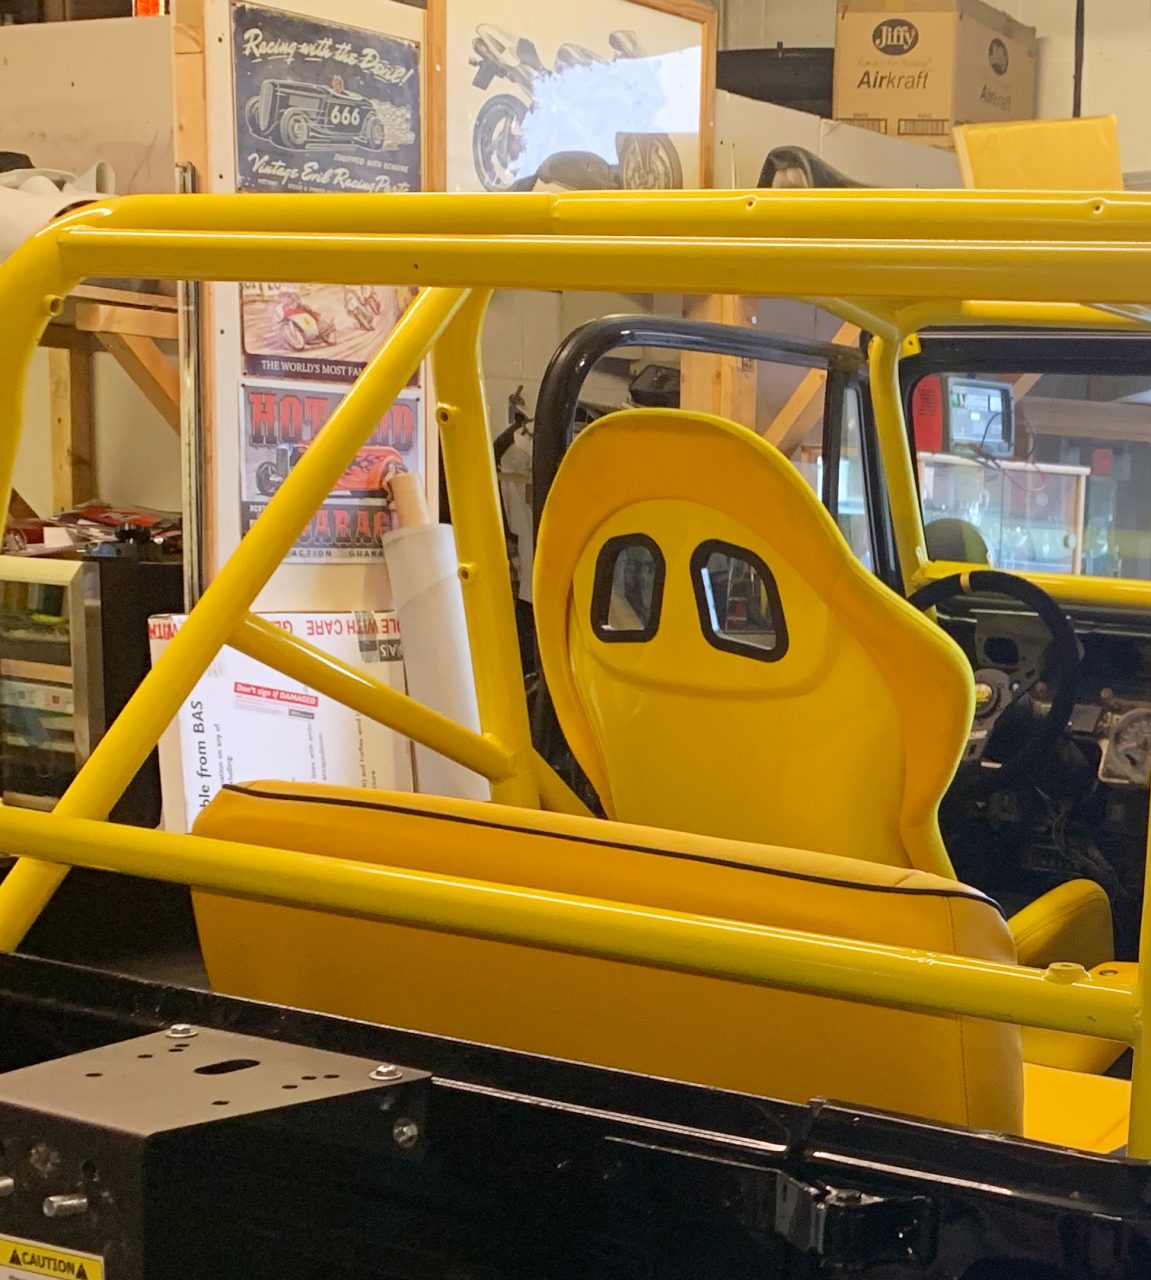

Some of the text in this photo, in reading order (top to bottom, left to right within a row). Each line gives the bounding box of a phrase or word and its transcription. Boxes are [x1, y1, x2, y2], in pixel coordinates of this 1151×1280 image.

[242, 28, 297, 65] Racing
[299, 38, 333, 59] with
[335, 42, 359, 65] the
[875, 26, 916, 50] Jiffy
[857, 70, 929, 90] Airkraft
[330, 105, 360, 125] 666
[248, 153, 300, 185] Vintage
[333, 168, 377, 192] Racing
[261, 360, 280, 371] THE
[281, 362, 320, 373] WORLD'S
[321, 365, 347, 376] MOST
[249, 392, 329, 448] HOT
[305, 619, 343, 636] CARE
[346, 618, 379, 635] WITH
[279, 691, 317, 705] DAMAGED
[191, 700, 212, 808] ble from BAS
[22, 1251, 76, 1275] CAUTION
